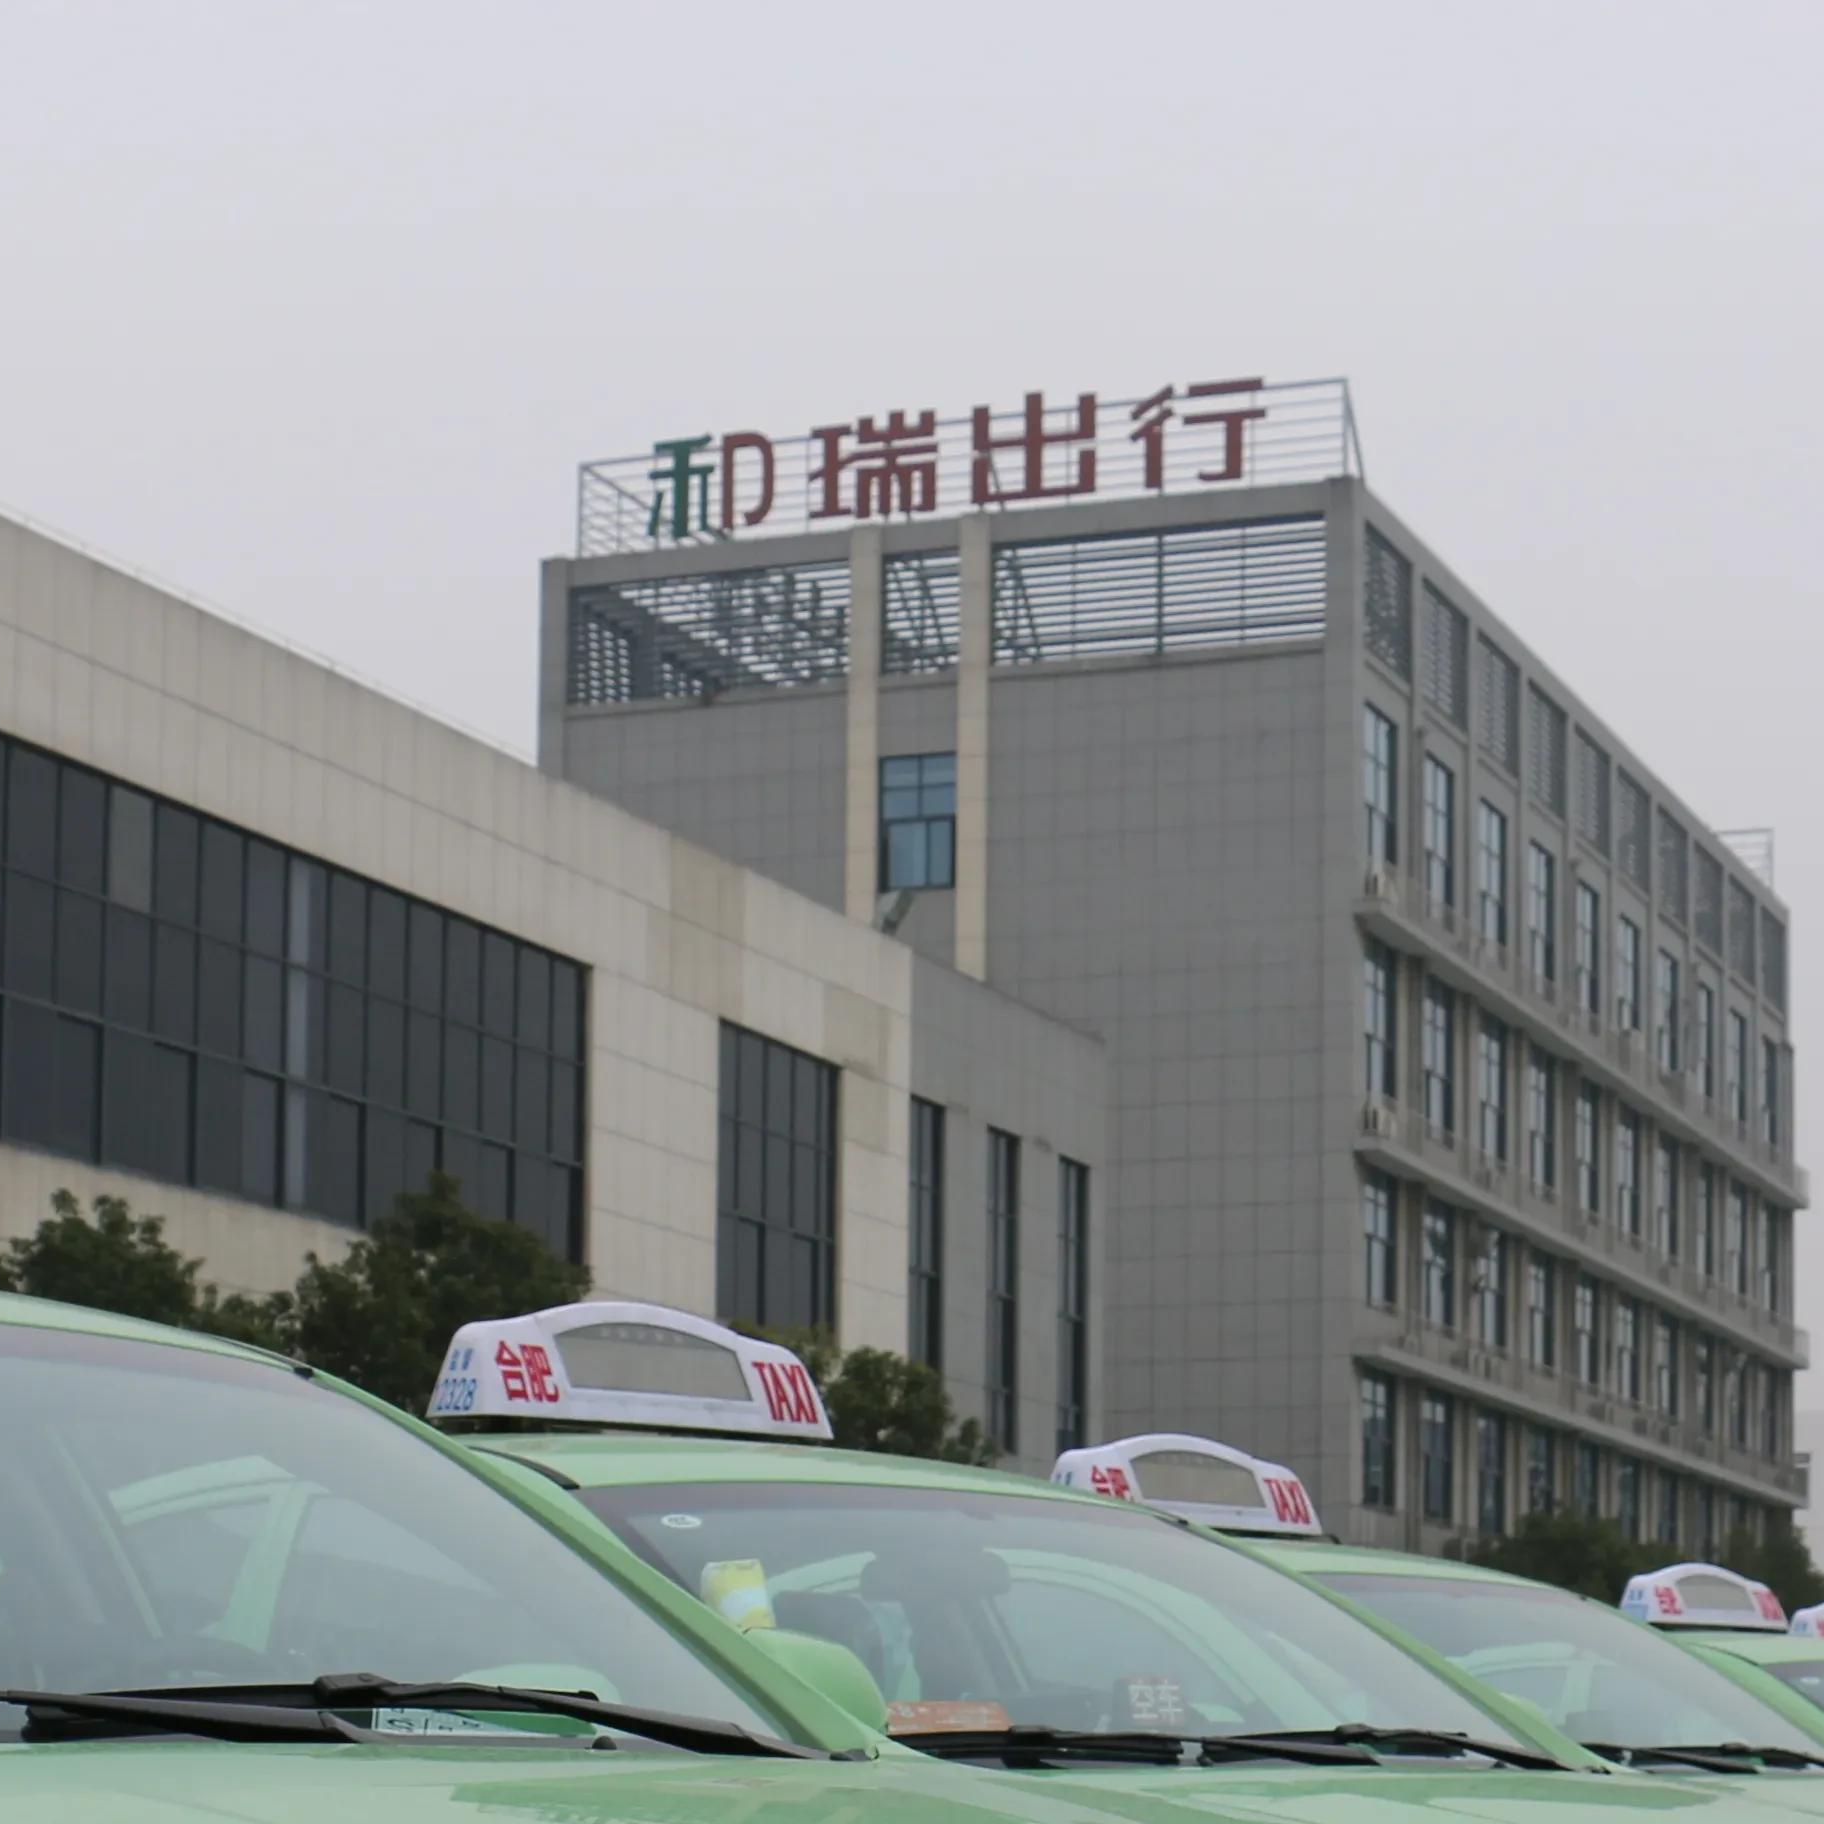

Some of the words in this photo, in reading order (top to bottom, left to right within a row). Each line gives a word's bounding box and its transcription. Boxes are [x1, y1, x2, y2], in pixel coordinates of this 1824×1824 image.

[648, 377, 1267, 539] 和瑞出行
[495, 1340, 559, 1402] 合肥
[753, 1360, 820, 1424] TAXI
[1264, 1478, 1311, 1524] TAXI
[1128, 1679, 1184, 1726] 空车
